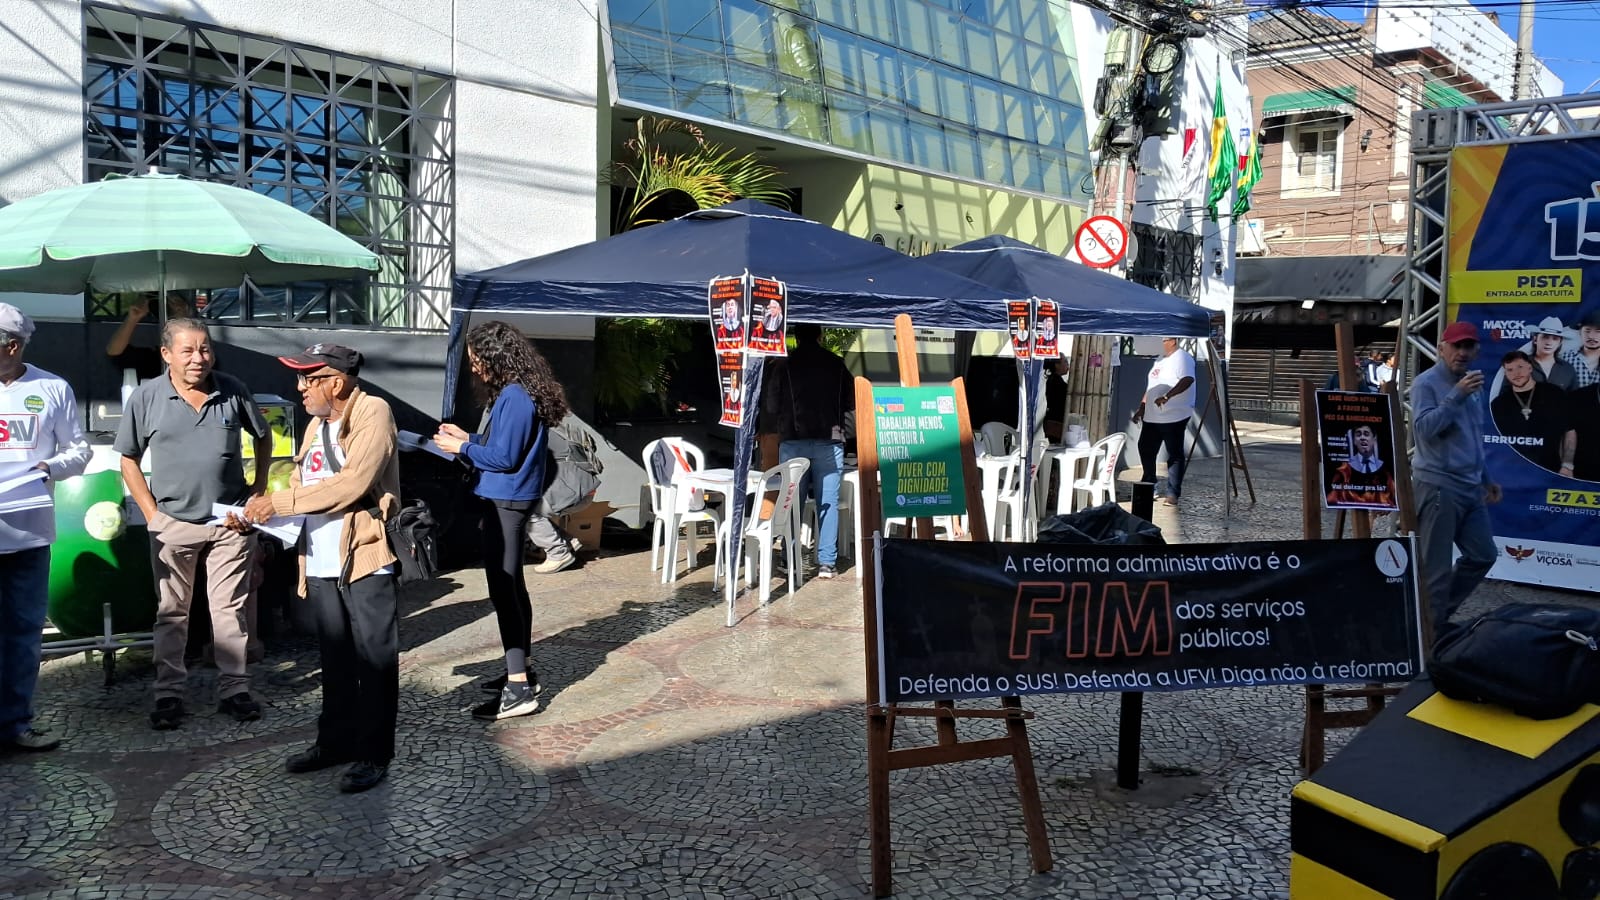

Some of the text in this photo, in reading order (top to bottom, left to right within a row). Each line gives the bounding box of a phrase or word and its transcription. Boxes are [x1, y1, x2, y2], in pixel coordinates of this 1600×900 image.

[1517, 275, 1575, 289] PISTA
[1486, 289, 1575, 298] ENTRADA GRATUITA
[1483, 320, 1526, 330] MAYCK
[1500, 329, 1531, 339] LYAN
[877, 415, 945, 431] TRABALHAR MENOS,
[879, 431, 925, 445] DISTRIBUIR A
[1482, 434, 1544, 447] ERRUGEM
[881, 445, 912, 463] RIQUEZA,
[897, 461, 946, 477] VIVER COM
[897, 477, 949, 494] DIGNIDADE!
[1551, 491, 1571, 503] 27
[1575, 493, 1588, 505] A
[1529, 504, 1596, 516] ESPAÇO ABERTO
[1004, 551, 1301, 573] A reforma administrativa é o
[1536, 555, 1573, 567] VIÇOSA
[1175, 598, 1306, 621] dos serviços
[1008, 580, 1173, 660] FIM
[1179, 627, 1270, 653] públicos!
[899, 658, 1414, 695] Defenda o SUS! Defenda a UFV! Diga não à reforma!
